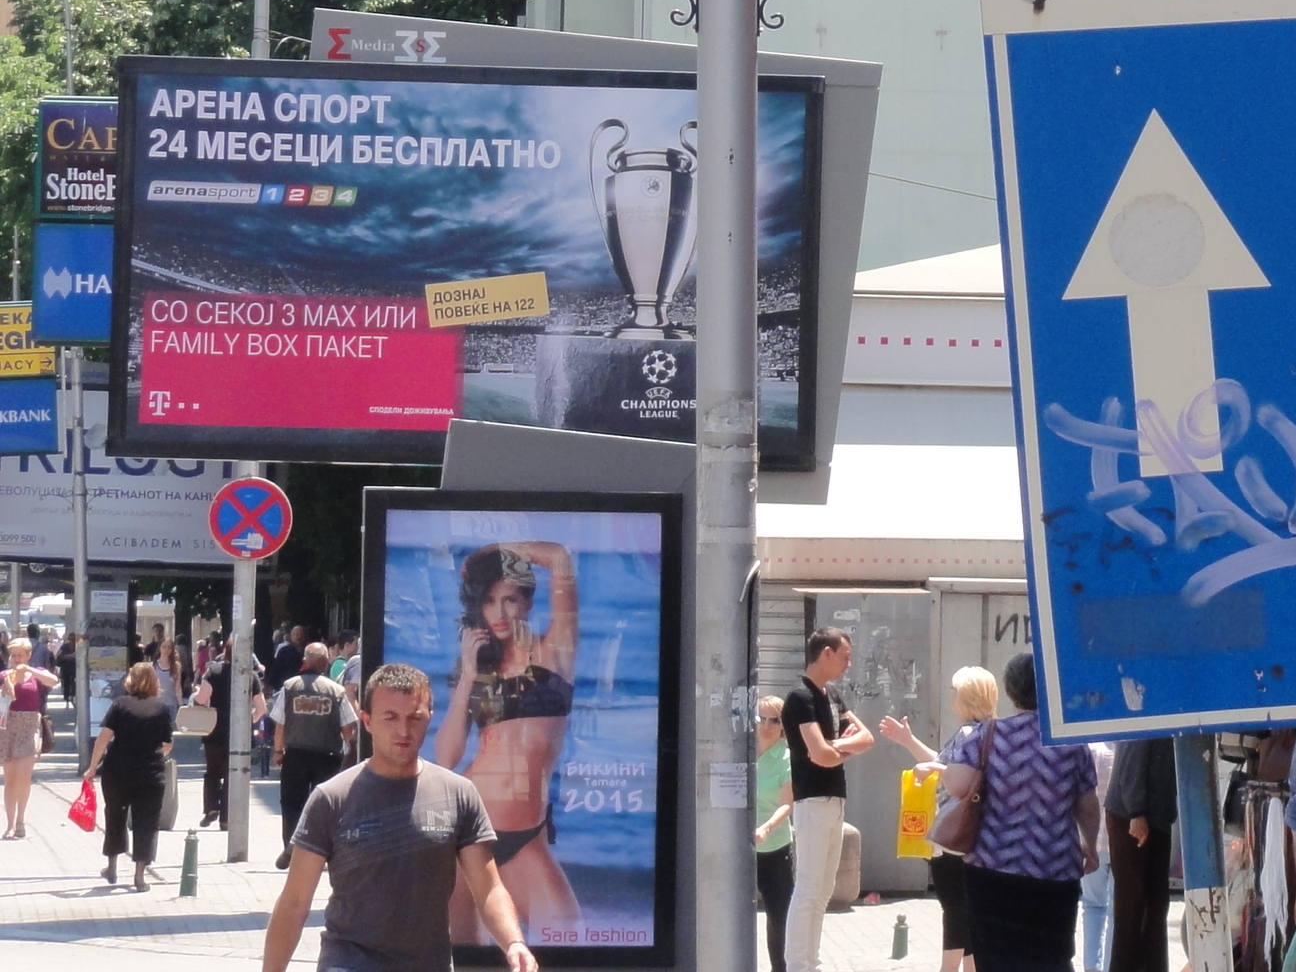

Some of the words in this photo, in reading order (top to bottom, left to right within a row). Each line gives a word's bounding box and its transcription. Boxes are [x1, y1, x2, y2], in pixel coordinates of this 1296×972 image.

[351, 38, 395, 52] Media
[149, 88, 266, 121] АРЕНА
[274, 92, 392, 124] СПОРТ
[148, 128, 188, 158] 24
[197, 130, 343, 166] МЕСЕЦИ
[352, 134, 562, 169] БЕСПЛАТНО
[66, 167, 104, 181] Hotel
[153, 183, 256, 199] arenasport
[432, 285, 487, 305] ДОЗНАЈ
[493, 299, 512, 314] НА
[513, 297, 536, 312] 122
[151, 299, 188, 324] СО
[195, 300, 274, 327] СЕКОЈ
[282, 302, 296, 327] 3
[365, 304, 416, 329] ИЛИ
[151, 331, 240, 356] FAMILY
[247, 332, 299, 357] BOX
[306, 334, 388, 359] ПАКЕТ
[0, 358, 34, 371] ACY
[646, 388, 671, 398] UEFA
[621, 399, 697, 409] CHAMPIONS
[639, 410, 678, 419] LEAGUE
[165, 491, 181, 501] НА
[565, 761, 645, 777] БИКИНИ
[584, 777, 627, 786] Tamara
[564, 789, 643, 813] 2015
[541, 927, 578, 942] Sara
[585, 927, 647, 943] fashion
